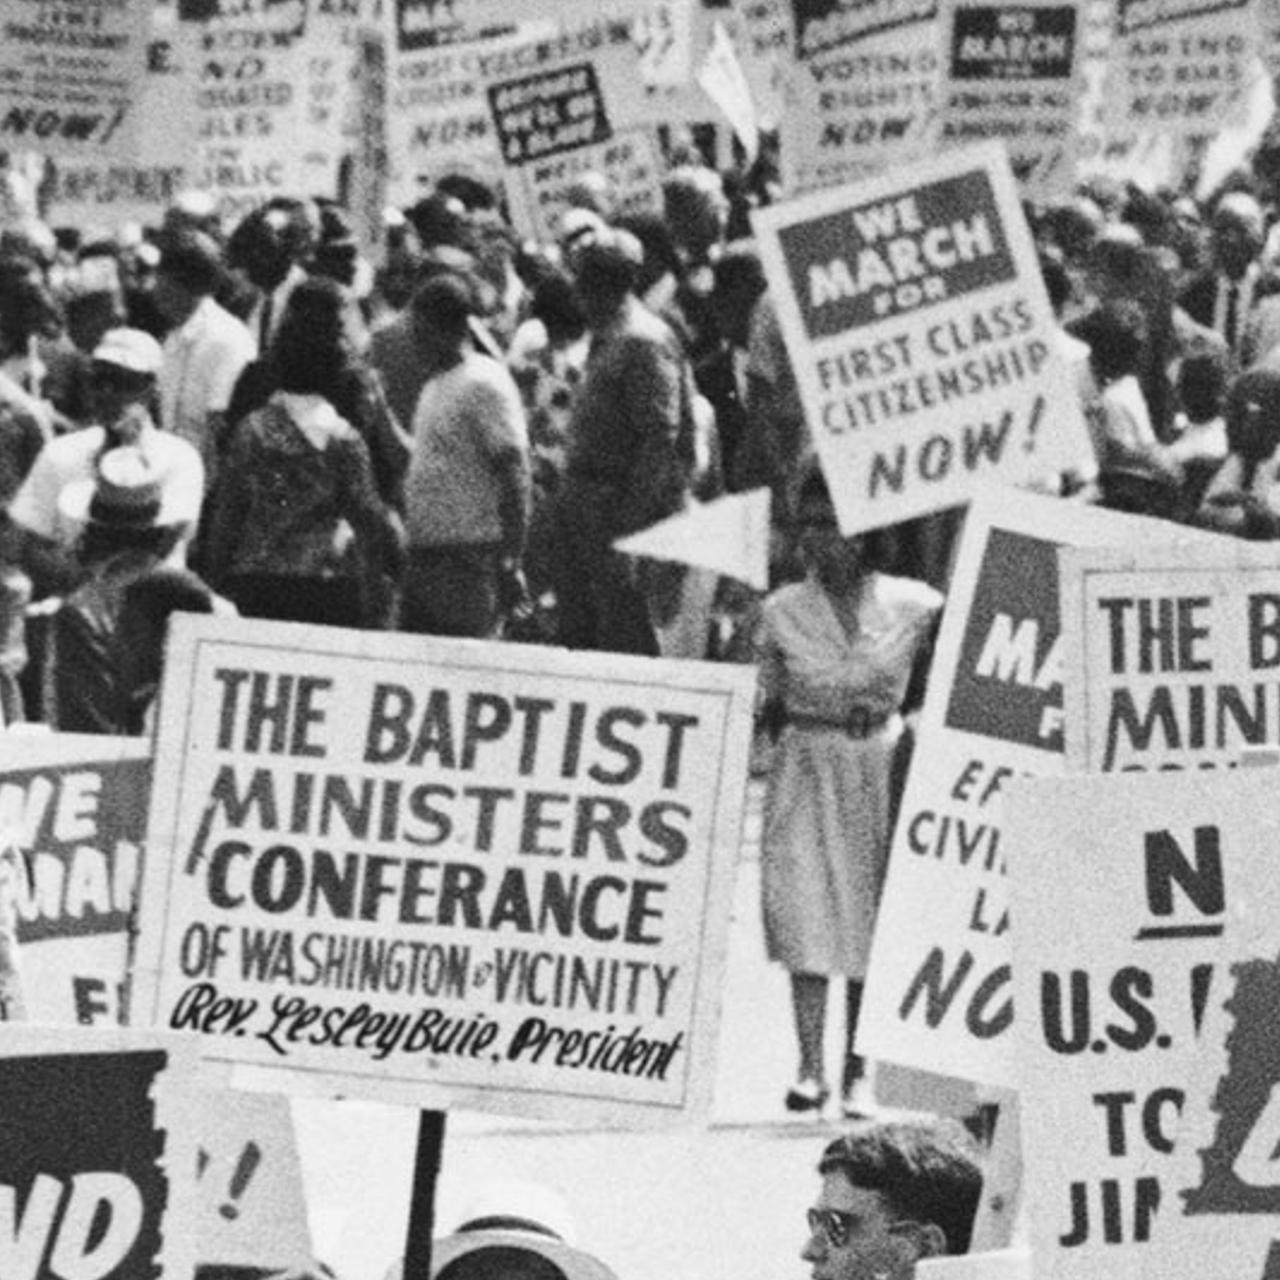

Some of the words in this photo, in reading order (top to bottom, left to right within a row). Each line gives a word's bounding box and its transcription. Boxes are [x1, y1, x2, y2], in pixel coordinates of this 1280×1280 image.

[806, 214, 997, 308] MARCH
[853, 194, 923, 242] WE
[872, 276, 948, 315] FOR
[816, 334, 912, 391] FIRST
[926, 300, 1035, 357] CLASS
[820, 339, 1050, 435] CITIZENSHIP
[868, 394, 1046, 499] NOW!
[1100, 595, 1213, 675] THE
[213, 667, 334, 758] THE
[362, 682, 699, 790] BAPTIST
[186, 765, 694, 875] MINISTERS
[907, 811, 1008, 876] CIVI
[205, 840, 669, 945] CONFERANCE
[180, 922, 231, 979] OF
[241, 925, 470, 999] WASHINGTON
[494, 948, 679, 1017] VICINITY
[169, 983, 260, 1037] Rev.
[506, 1018, 684, 1081] President
